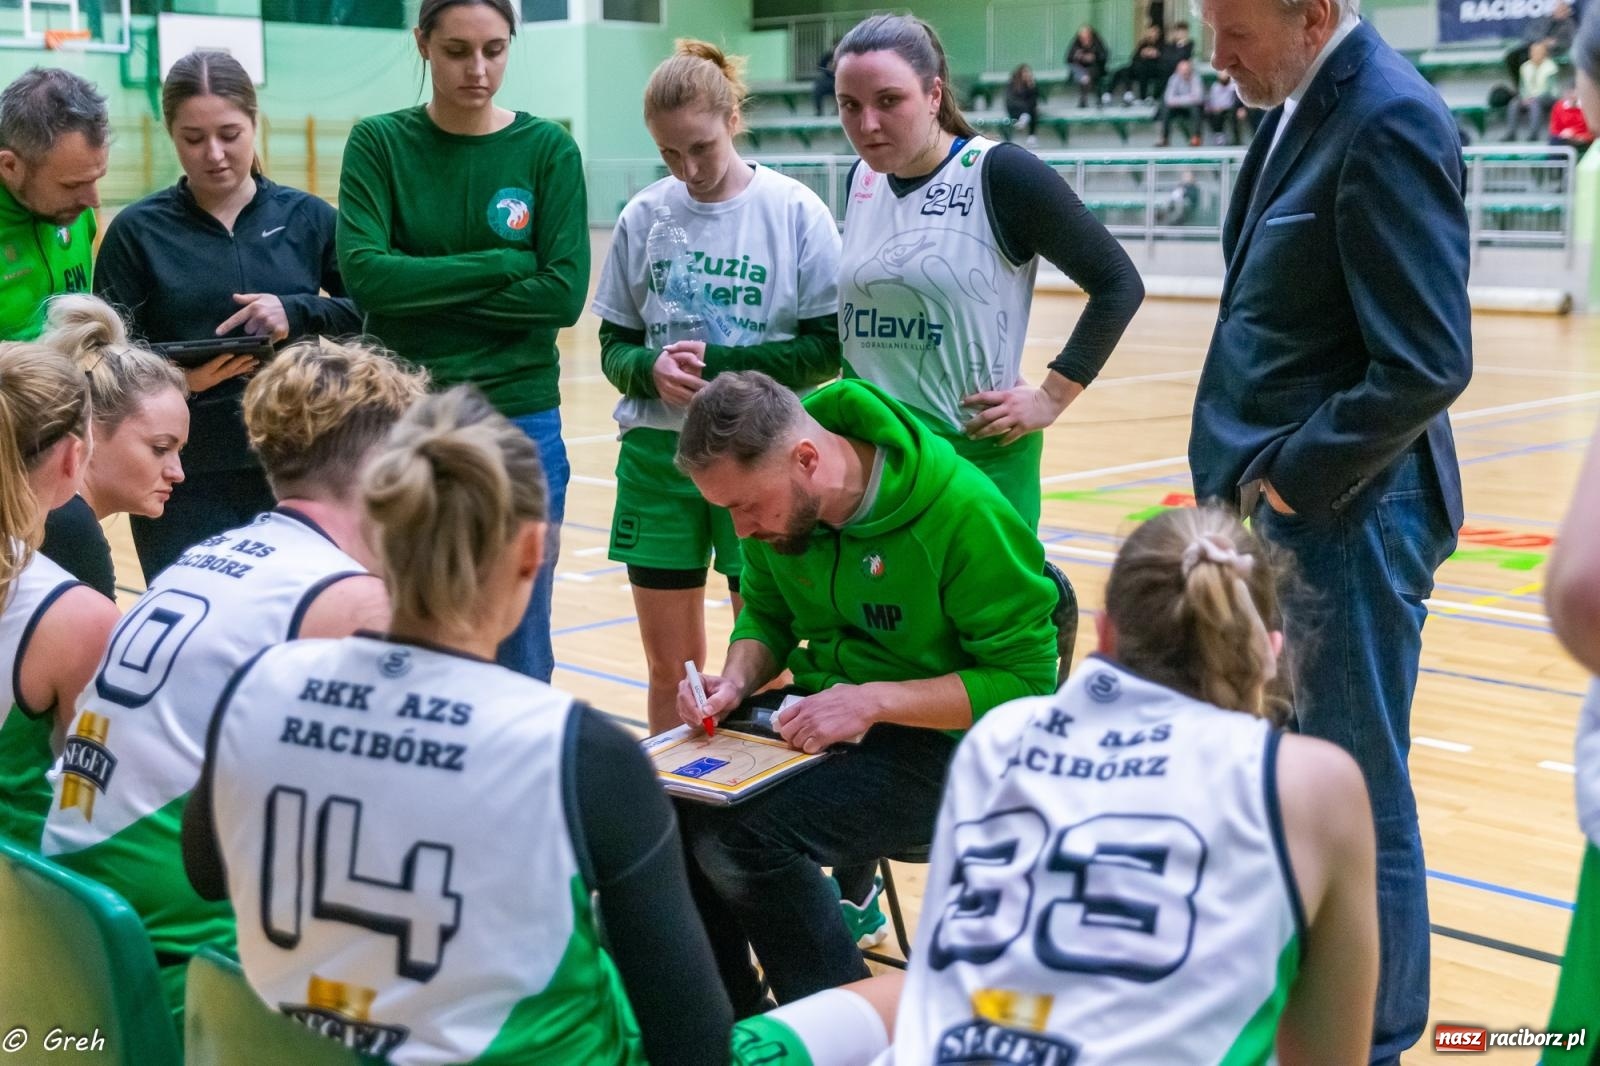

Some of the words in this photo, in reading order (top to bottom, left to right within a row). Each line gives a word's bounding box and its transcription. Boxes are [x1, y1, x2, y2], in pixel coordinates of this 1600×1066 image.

[920, 182, 974, 217] 24
[686, 251, 767, 284] Zuzia
[855, 308, 944, 346] Clavis
[230, 539, 276, 558] AZS
[862, 602, 903, 632] MP
[299, 677, 375, 711] RKK
[397, 692, 473, 725] AZS
[280, 716, 468, 772] RACIBÓRZ
[259, 784, 463, 983] 14
